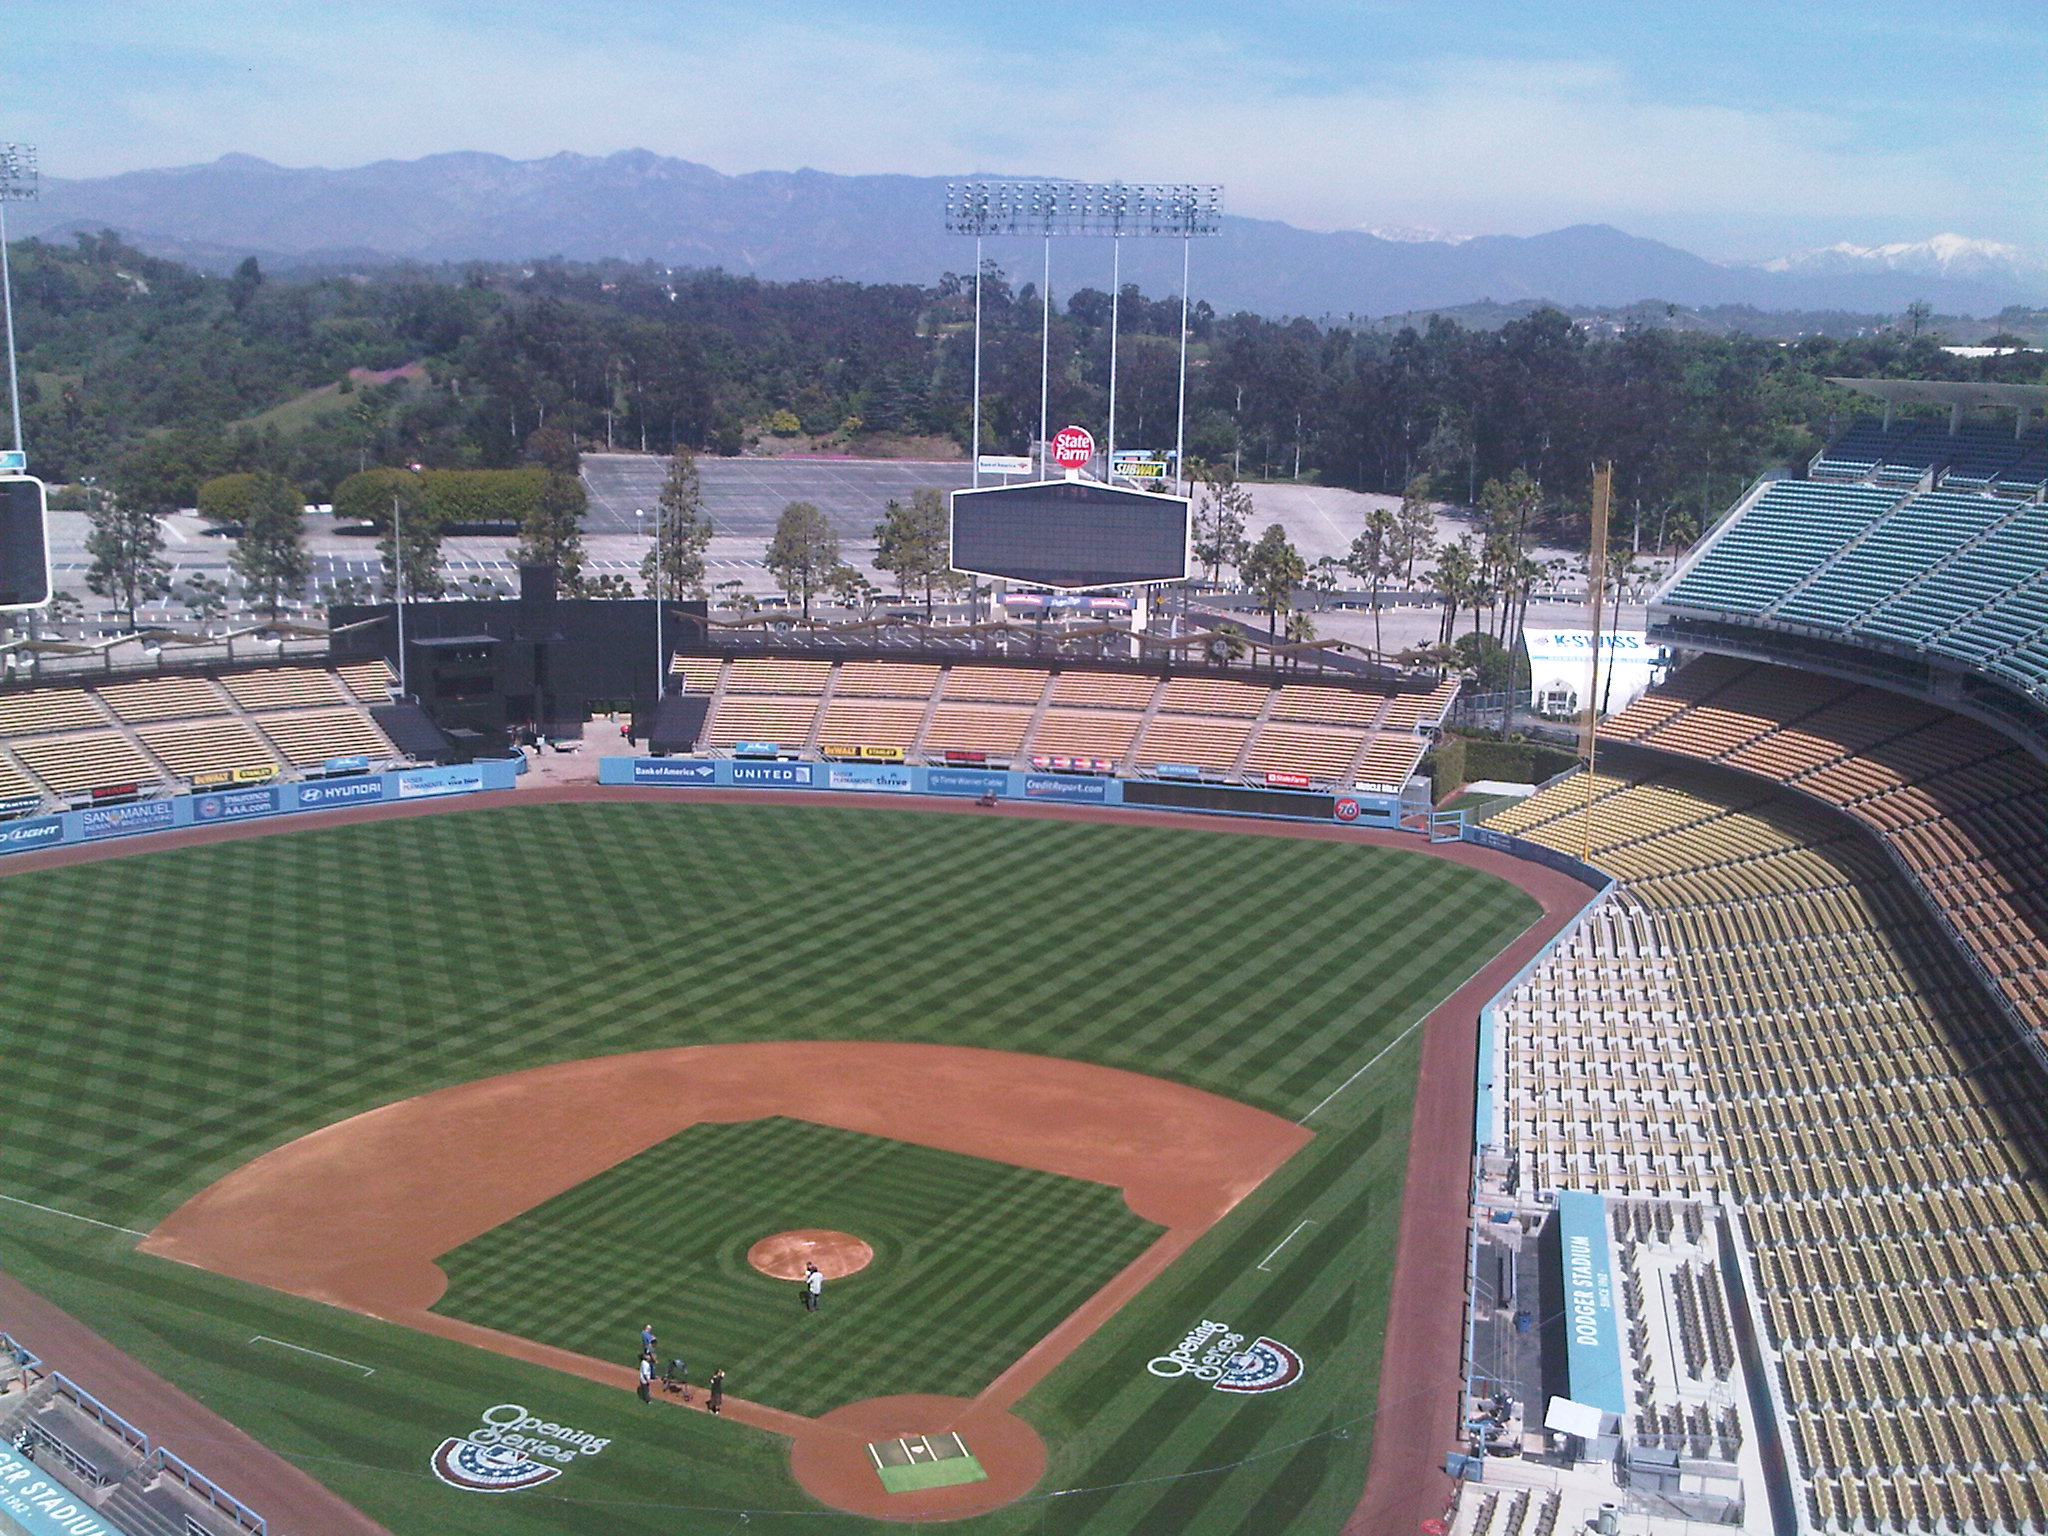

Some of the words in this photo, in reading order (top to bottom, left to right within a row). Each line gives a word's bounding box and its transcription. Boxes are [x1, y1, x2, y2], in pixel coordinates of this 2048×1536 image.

[1056, 433, 1090, 448] State
[1056, 447, 1089, 461] Farm
[1114, 463, 1159, 476] SUBWAY
[636, 767, 654, 775] Bank
[654, 767, 664, 775] of
[664, 768, 694, 776] America
[734, 770, 792, 779] UNITED
[876, 776, 908, 786] thrive
[1026, 780, 1103, 793] CreditReport.com
[224, 792, 270, 803] Insurance
[326, 783, 381, 798] HYUNDAI
[84, 812, 110, 825] SAN
[120, 802, 173, 819] MANUEL
[224, 802, 272, 815] AAA.com
[1339, 803, 1355, 815] 76
[16, 825, 59, 838] LIGHT
[1570, 1236, 1592, 1288] STADIUM
[1574, 1290, 1598, 1346] DODGER
[1147, 1320, 1230, 1377] Opening
[1189, 1332, 1244, 1380] Series
[482, 1404, 612, 1456] Opening
[468, 1424, 578, 1463] Series
[0, 1452, 31, 1484] GER
[20, 1482, 107, 1536] STADIU
[4, 1494, 30, 1513] 1962
